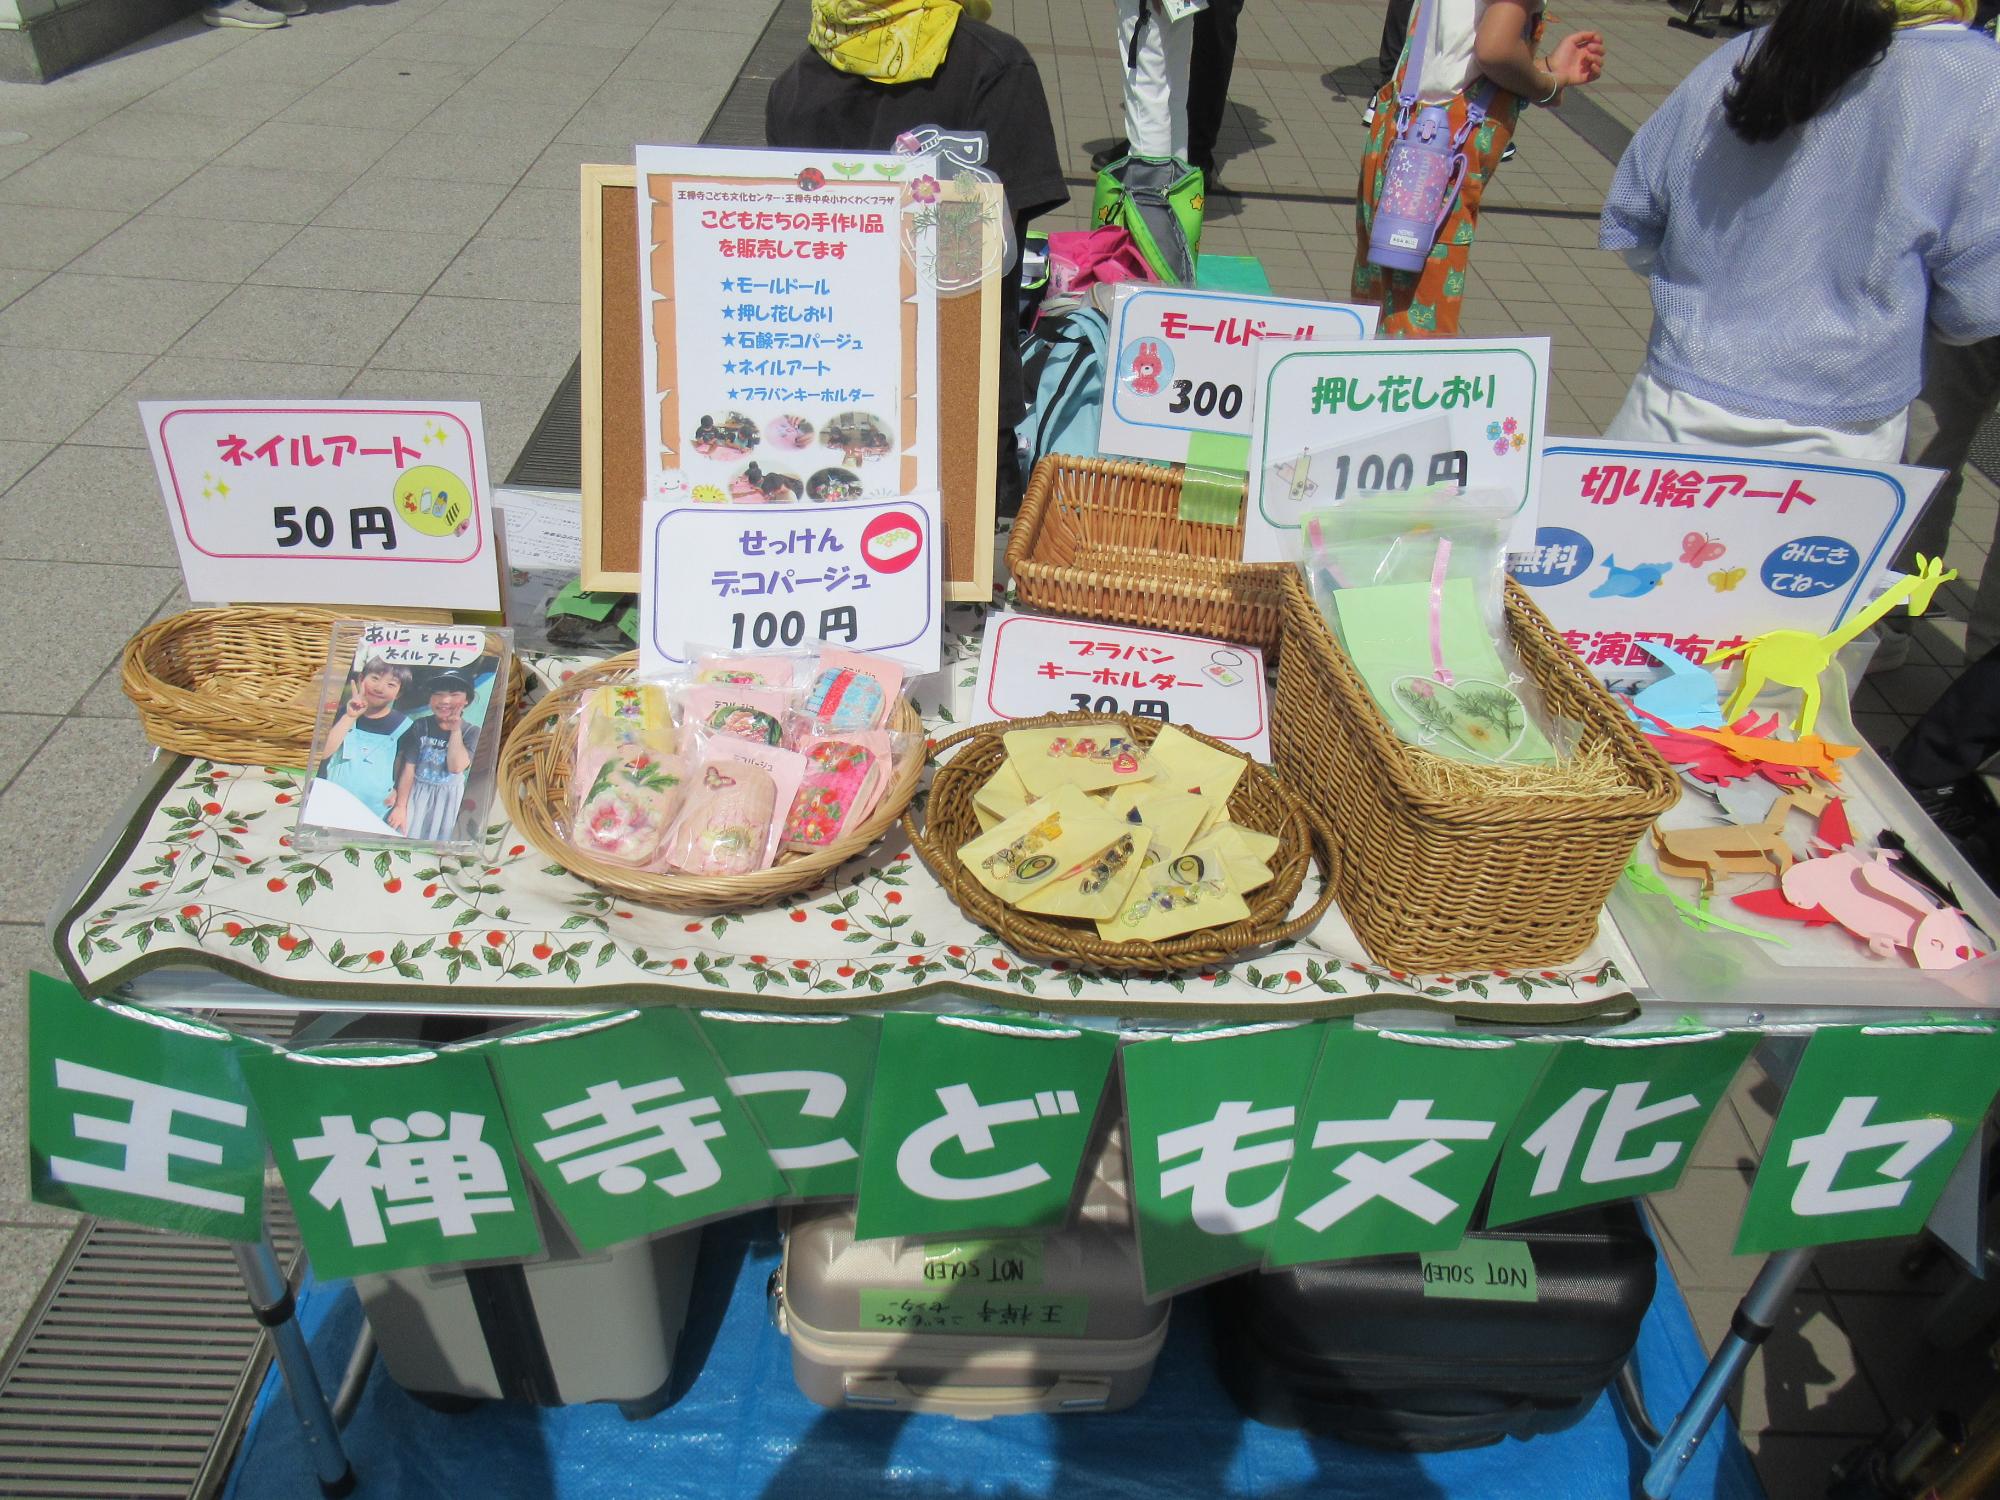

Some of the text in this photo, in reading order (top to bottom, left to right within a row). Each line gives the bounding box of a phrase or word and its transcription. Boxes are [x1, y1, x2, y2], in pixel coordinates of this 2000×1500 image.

[701, 209, 885, 234] こどもたちの手作り品
[718, 238, 848, 260] を販売してます
[737, 276, 830, 296] モールドール
[737, 304, 834, 323] 押し花しおり
[738, 331, 864, 350] 石鹸デコパージュ
[1160, 312, 1315, 347] モールドール
[739, 359, 831, 377] ネイルアート
[1169, 379, 1243, 420] 300
[1311, 374, 1496, 414] 押し花しおり
[216, 434, 422, 469] ネイルアート
[1335, 450, 1468, 500] 100 円
[1580, 465, 1817, 514] 切り絵アート
[273, 506, 398, 550] 50 円
[738, 527, 845, 556] せっけん
[1781, 542, 1848, 565] みにき
[711, 565, 872, 598] デコパージュ
[732, 605, 858, 650] 100 円
[1069, 640, 1175, 665] プラバン
[1037, 661, 1204, 691] キーホルダー
[1131, 699, 1170, 722] 円
[924, 1257, 1024, 1283] NOT SOLED
[1423, 1262, 1527, 1289] NOT SOLED
